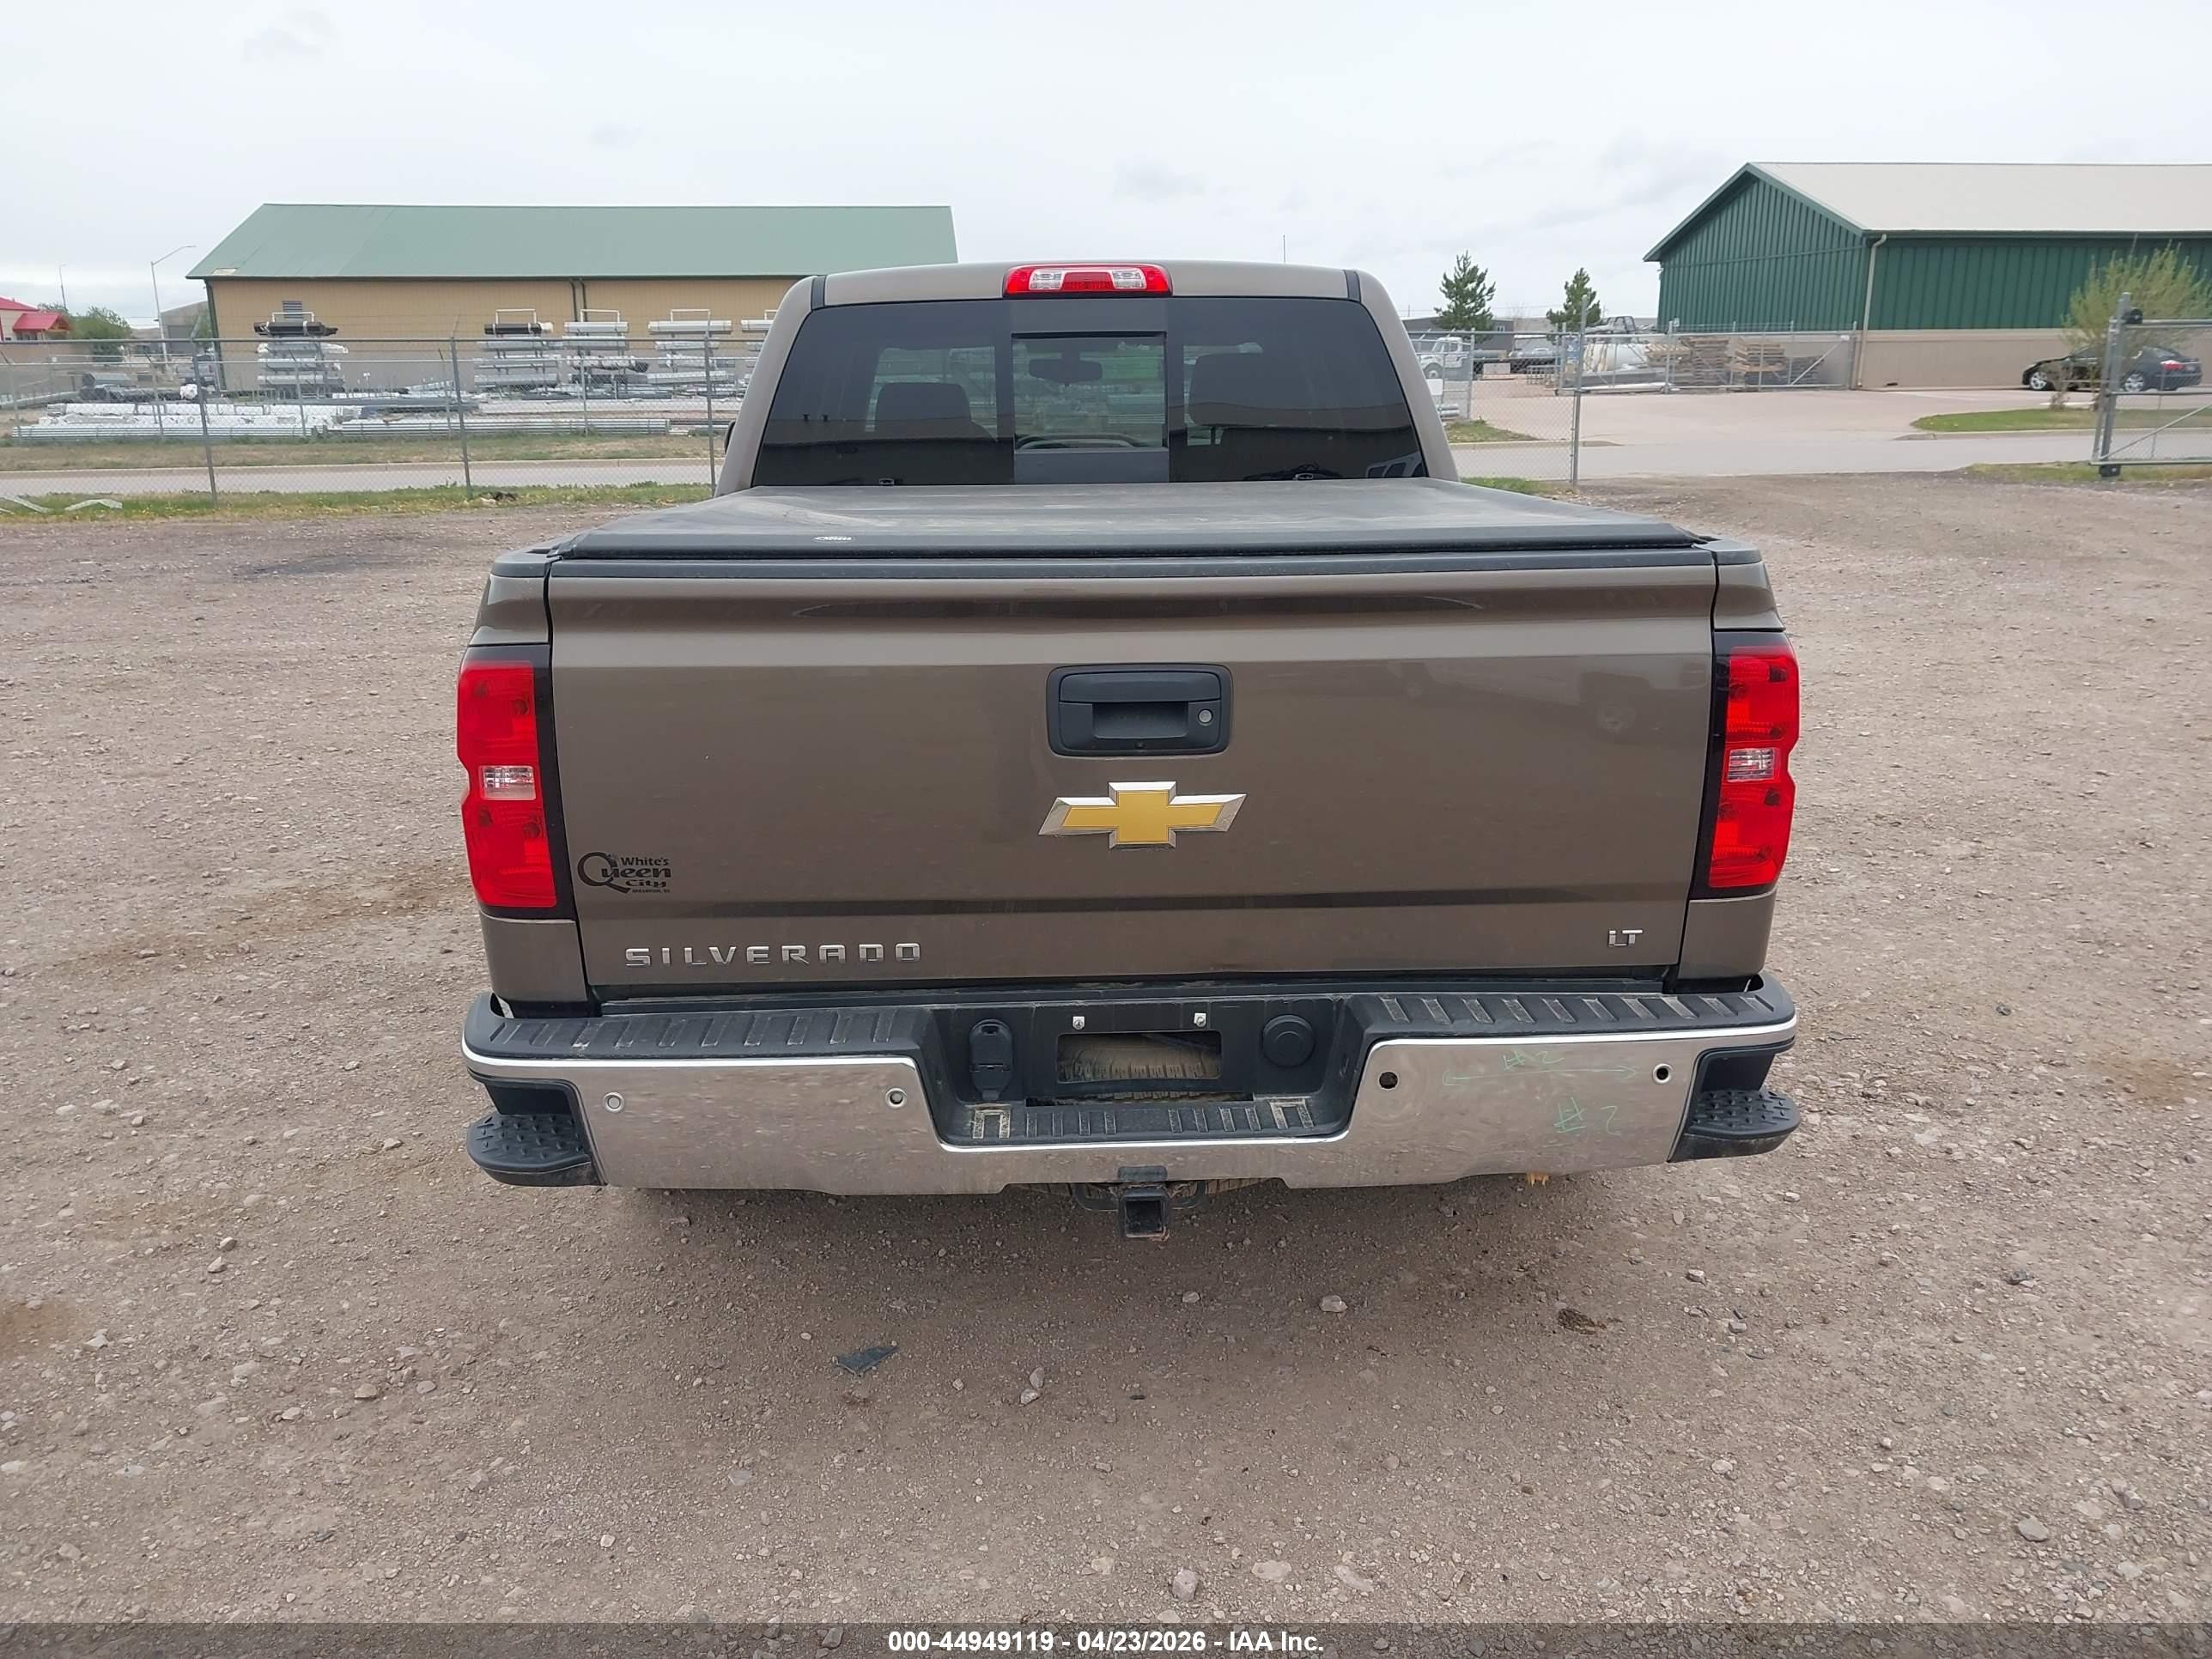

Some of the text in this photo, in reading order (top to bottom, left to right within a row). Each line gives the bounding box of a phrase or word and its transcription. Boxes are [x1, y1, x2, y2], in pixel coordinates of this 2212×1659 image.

[620, 857, 669, 866] White's
[577, 852, 672, 894] Queen
[1608, 929, 1644, 946] LT
[625, 942, 921, 967] SILVERADO
